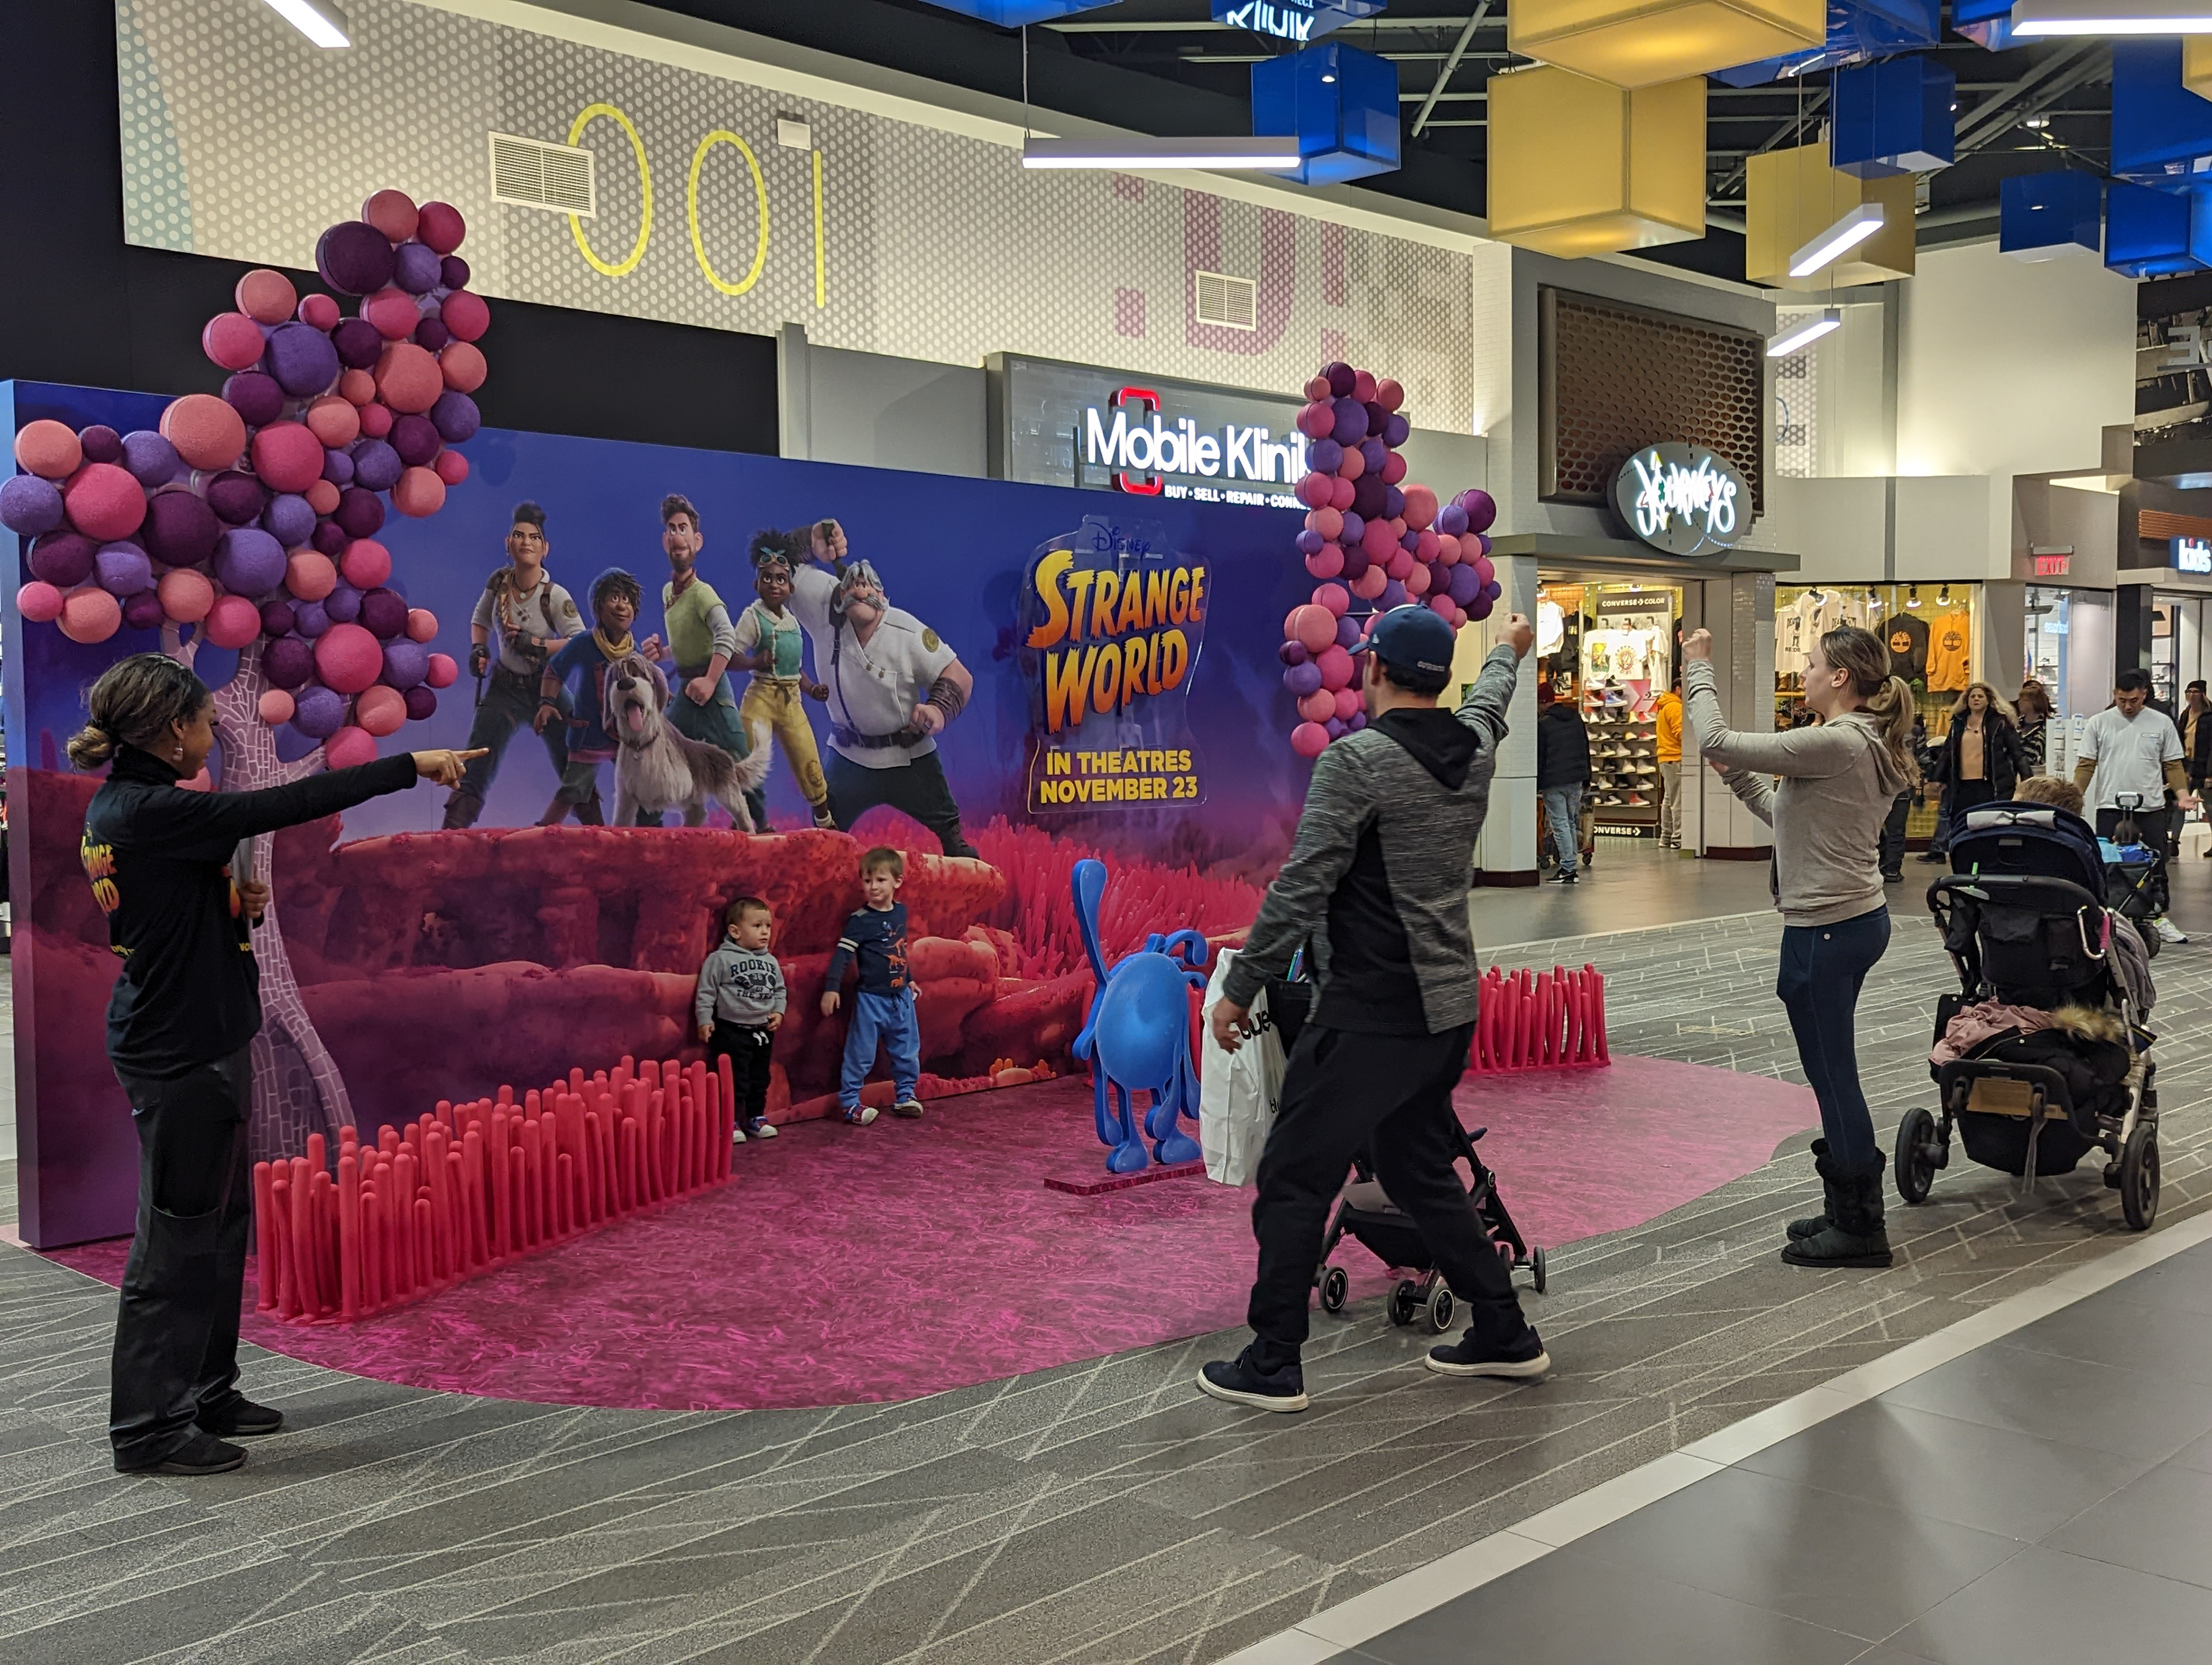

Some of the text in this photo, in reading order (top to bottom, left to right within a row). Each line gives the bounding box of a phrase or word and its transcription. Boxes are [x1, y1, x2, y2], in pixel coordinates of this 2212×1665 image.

[1086, 407, 1221, 477] Mobile
[1165, 485, 1187, 499] BUY
[1194, 487, 1221, 503] SELL
[1226, 491, 1264, 507] REPAIR
[2037, 556, 2064, 575] EXIT
[2179, 537, 2212, 573] kids
[1025, 549, 1206, 649] STRANGE
[1601, 597, 1665, 608] CONVERSE COLOR
[1043, 628, 1190, 735] WORLD
[1046, 749, 1192, 776] IN THEATRES
[1040, 776, 1198, 805] NOVEMBER 23
[1593, 825, 1633, 836] ONVERSE
[730, 958, 777, 978] ROOKIE
[736, 989, 755, 999] THE
